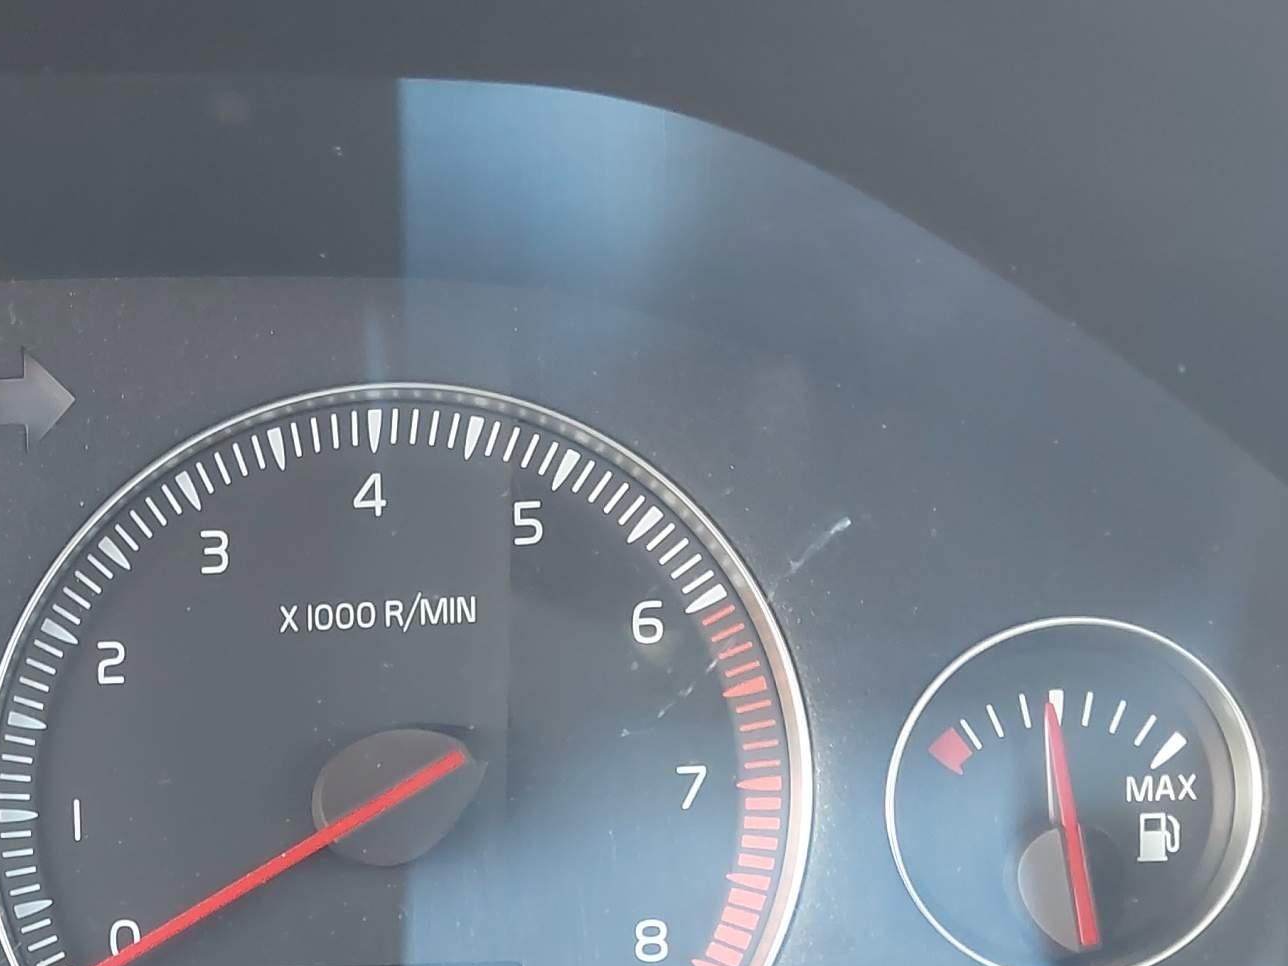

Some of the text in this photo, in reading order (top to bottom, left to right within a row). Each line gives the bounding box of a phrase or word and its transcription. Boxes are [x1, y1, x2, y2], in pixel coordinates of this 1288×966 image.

[354, 473, 386, 516] 4
[515, 501, 542, 545] 5
[201, 531, 228, 573] 3
[281, 593, 475, 632] X 1000 R/MIN
[633, 601, 663, 643] 6
[98, 642, 124, 683] 2
[677, 766, 706, 809] 7
[1127, 772, 1196, 801] MAX
[74, 800, 80, 840] 1
[636, 920, 667, 961] 8
